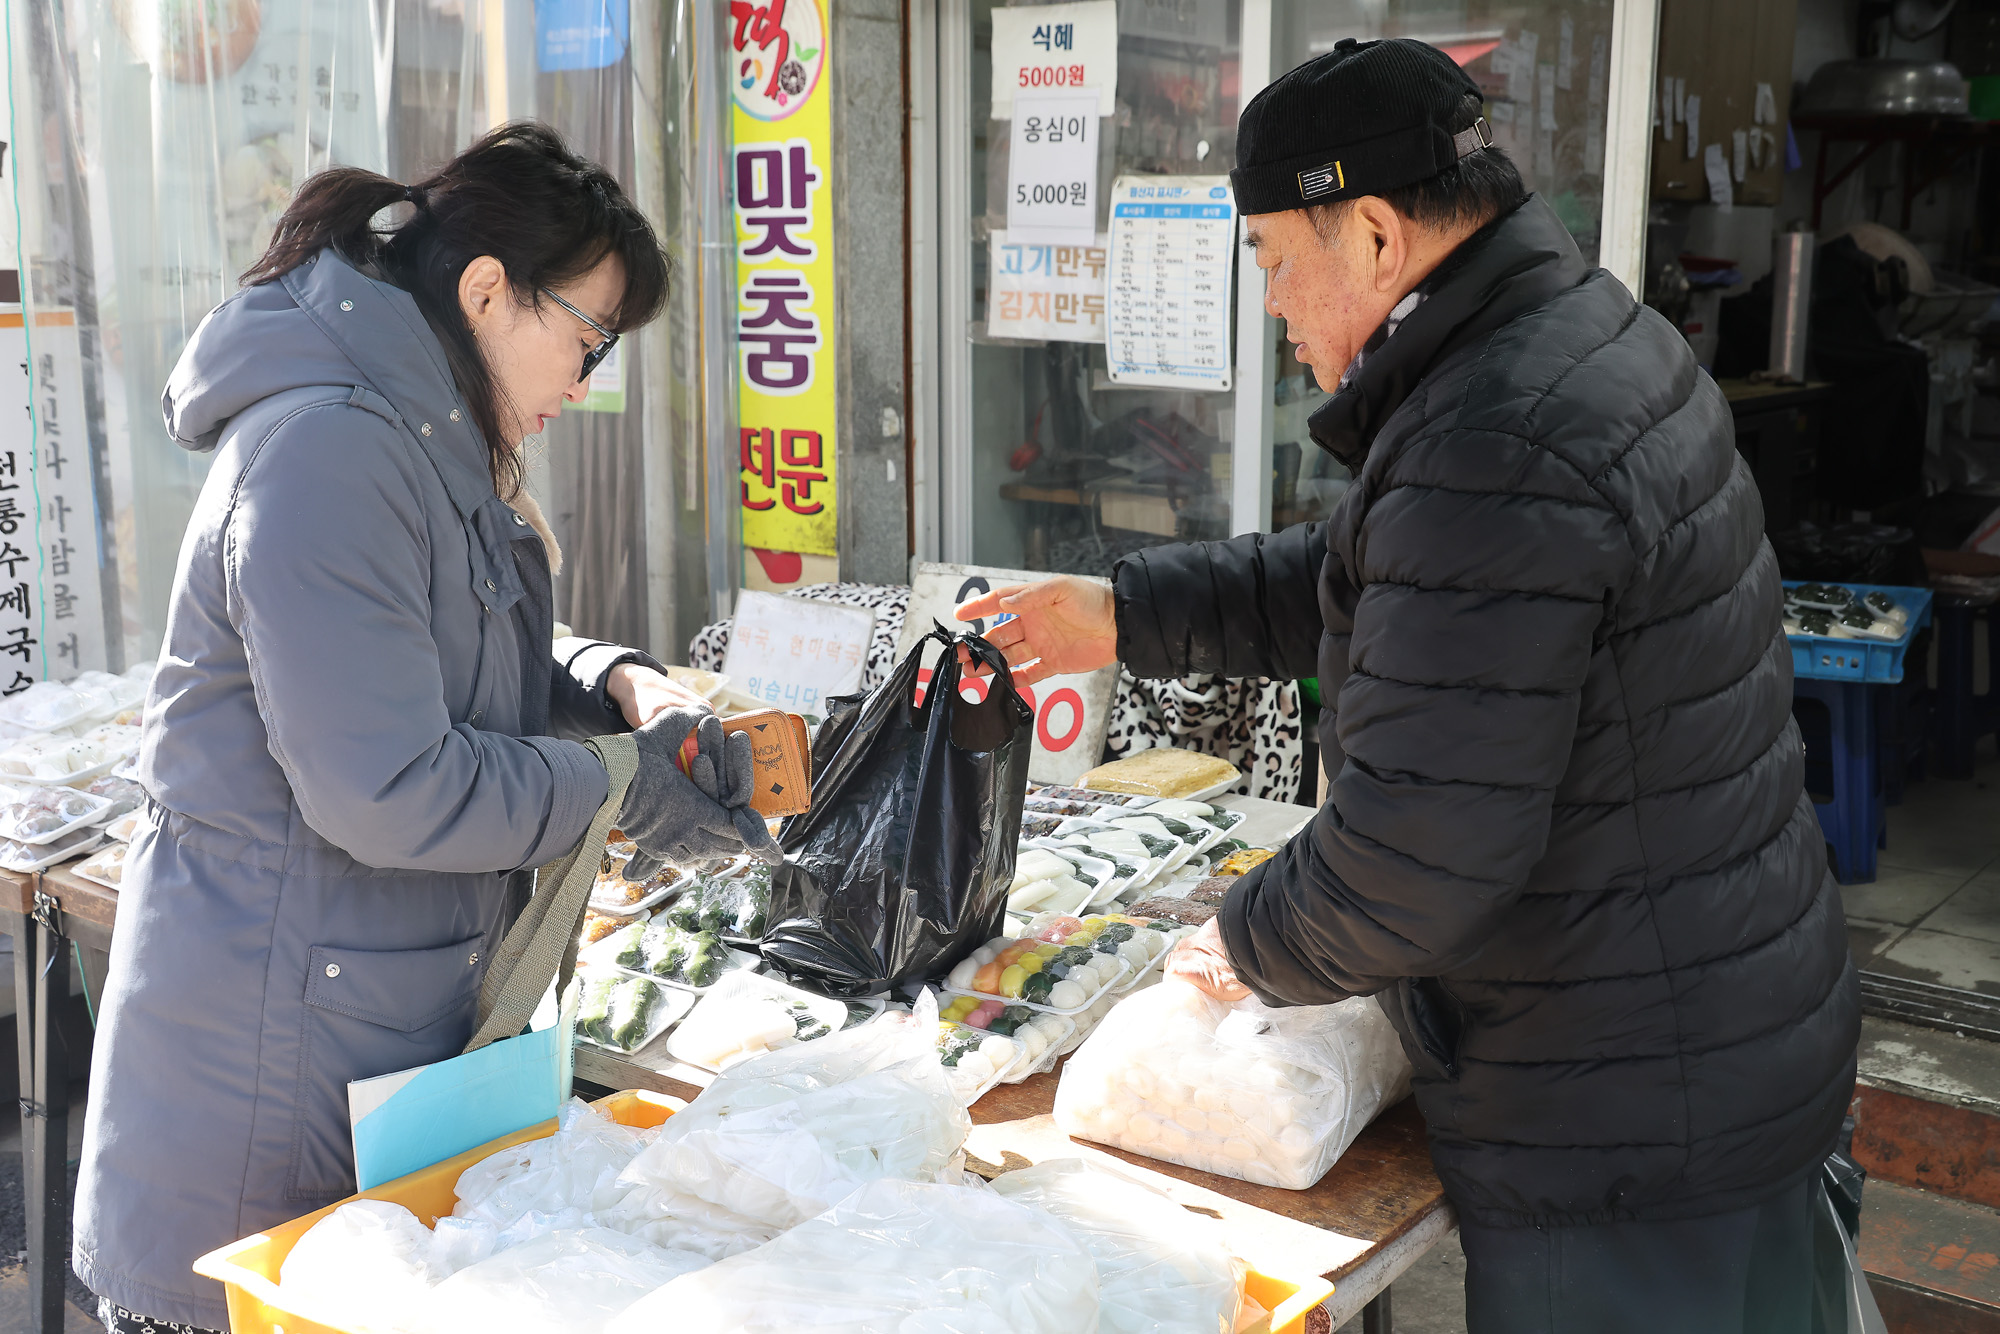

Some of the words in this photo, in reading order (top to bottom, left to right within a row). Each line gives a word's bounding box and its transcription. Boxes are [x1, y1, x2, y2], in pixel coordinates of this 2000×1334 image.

[1032, 23, 1074, 51] 식혜
[1018, 65, 1085, 88] 5000원
[1024, 116, 1086, 144] 옹심이
[1016, 181, 1087, 206] 5,000원
[736, 146, 817, 388] 맞춤
[999, 245, 1106, 279] 고기만두
[998, 291, 1105, 326] 김치만두
[740, 426, 828, 516] 전문
[748, 676, 820, 710] 있습니다
[753, 743, 781, 757] MCM
